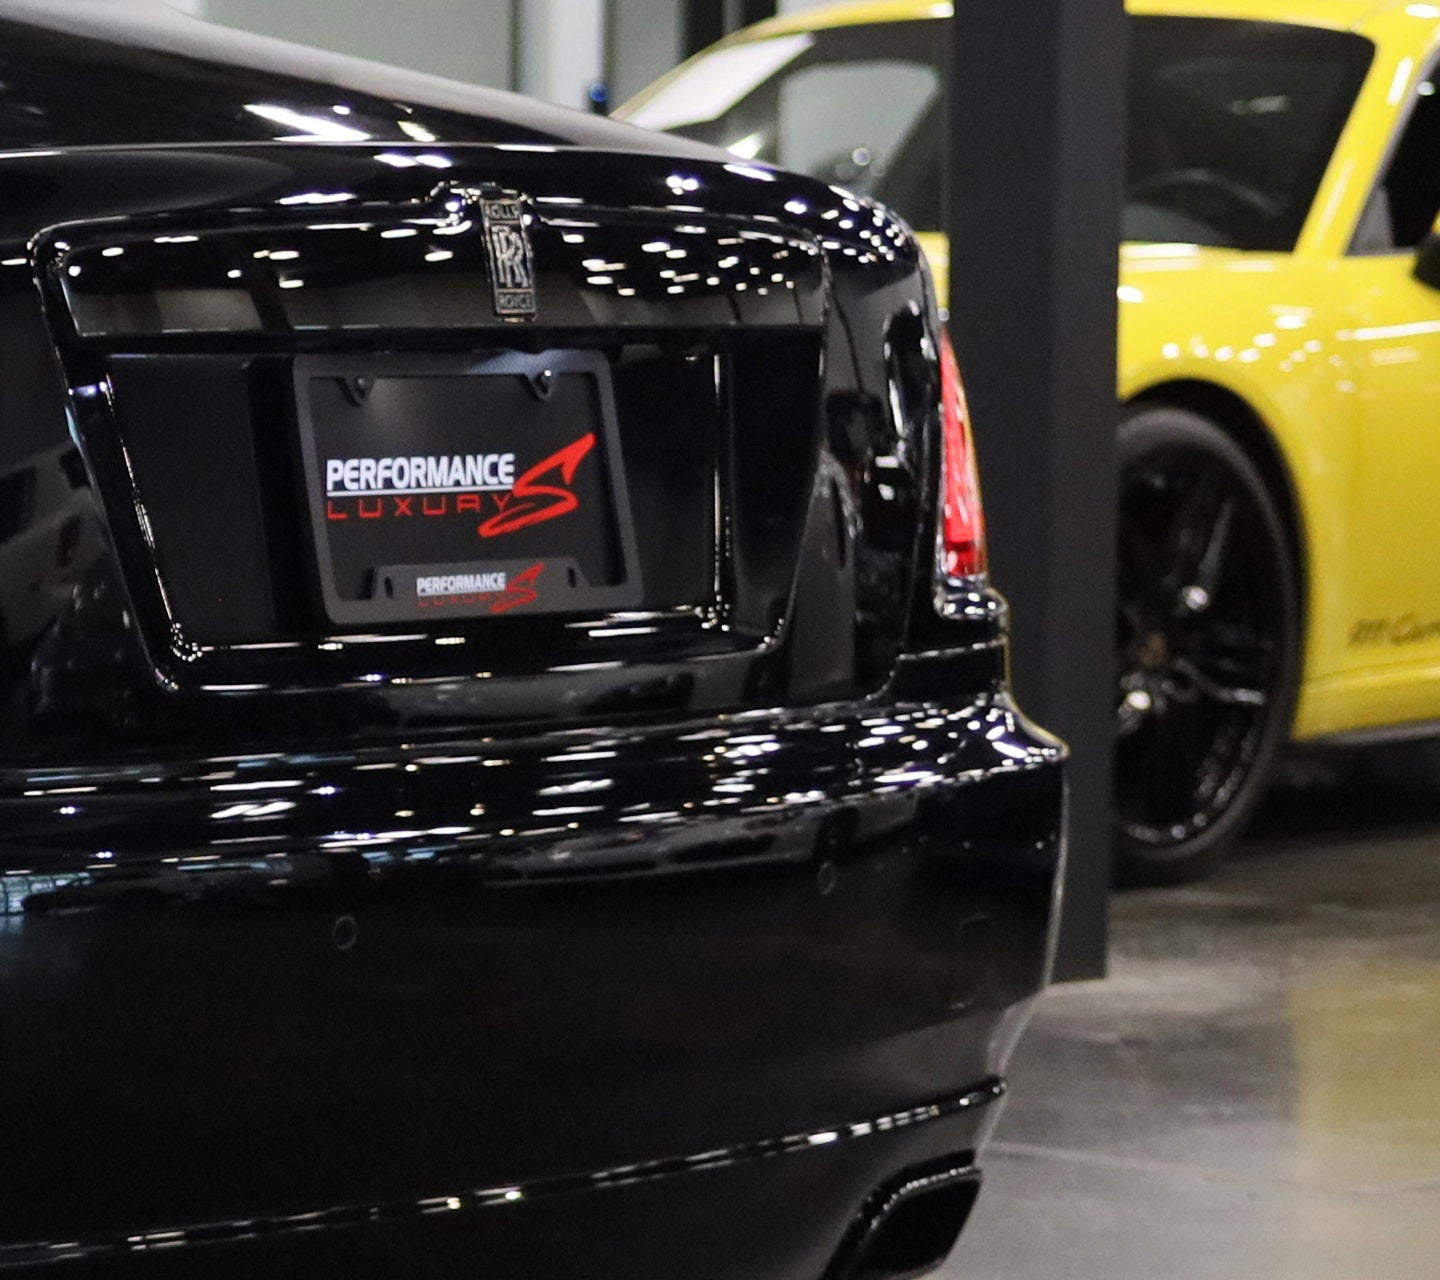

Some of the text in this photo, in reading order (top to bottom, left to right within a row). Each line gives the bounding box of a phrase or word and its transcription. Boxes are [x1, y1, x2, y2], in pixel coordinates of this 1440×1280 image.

[484, 203, 521, 220] ROLLS
[498, 293, 533, 309] ROYCE
[326, 453, 515, 491] PERFORMANCE
[327, 493, 512, 519] LUXURY
[416, 572, 506, 593] PERFORMANCE
